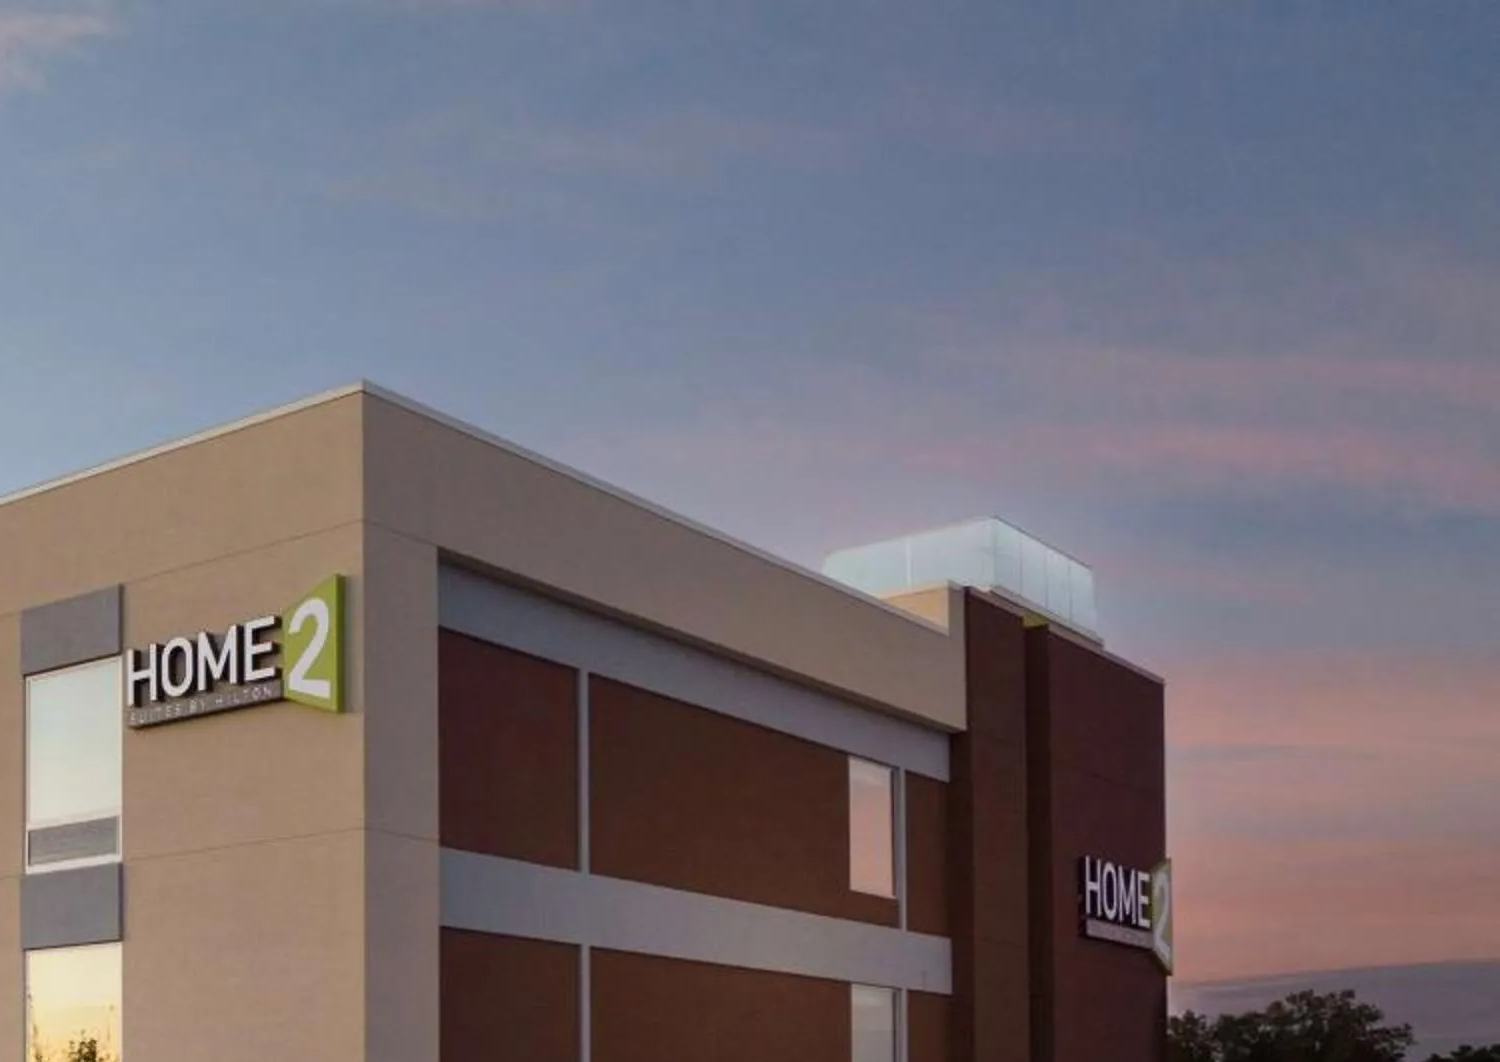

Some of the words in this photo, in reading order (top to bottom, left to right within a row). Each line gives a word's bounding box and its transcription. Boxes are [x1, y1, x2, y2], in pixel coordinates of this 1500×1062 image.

[127, 616, 275, 706] HOME
[288, 597, 331, 699] 2
[1085, 855, 1151, 929] HOME
[1152, 871, 1170, 970] 2
